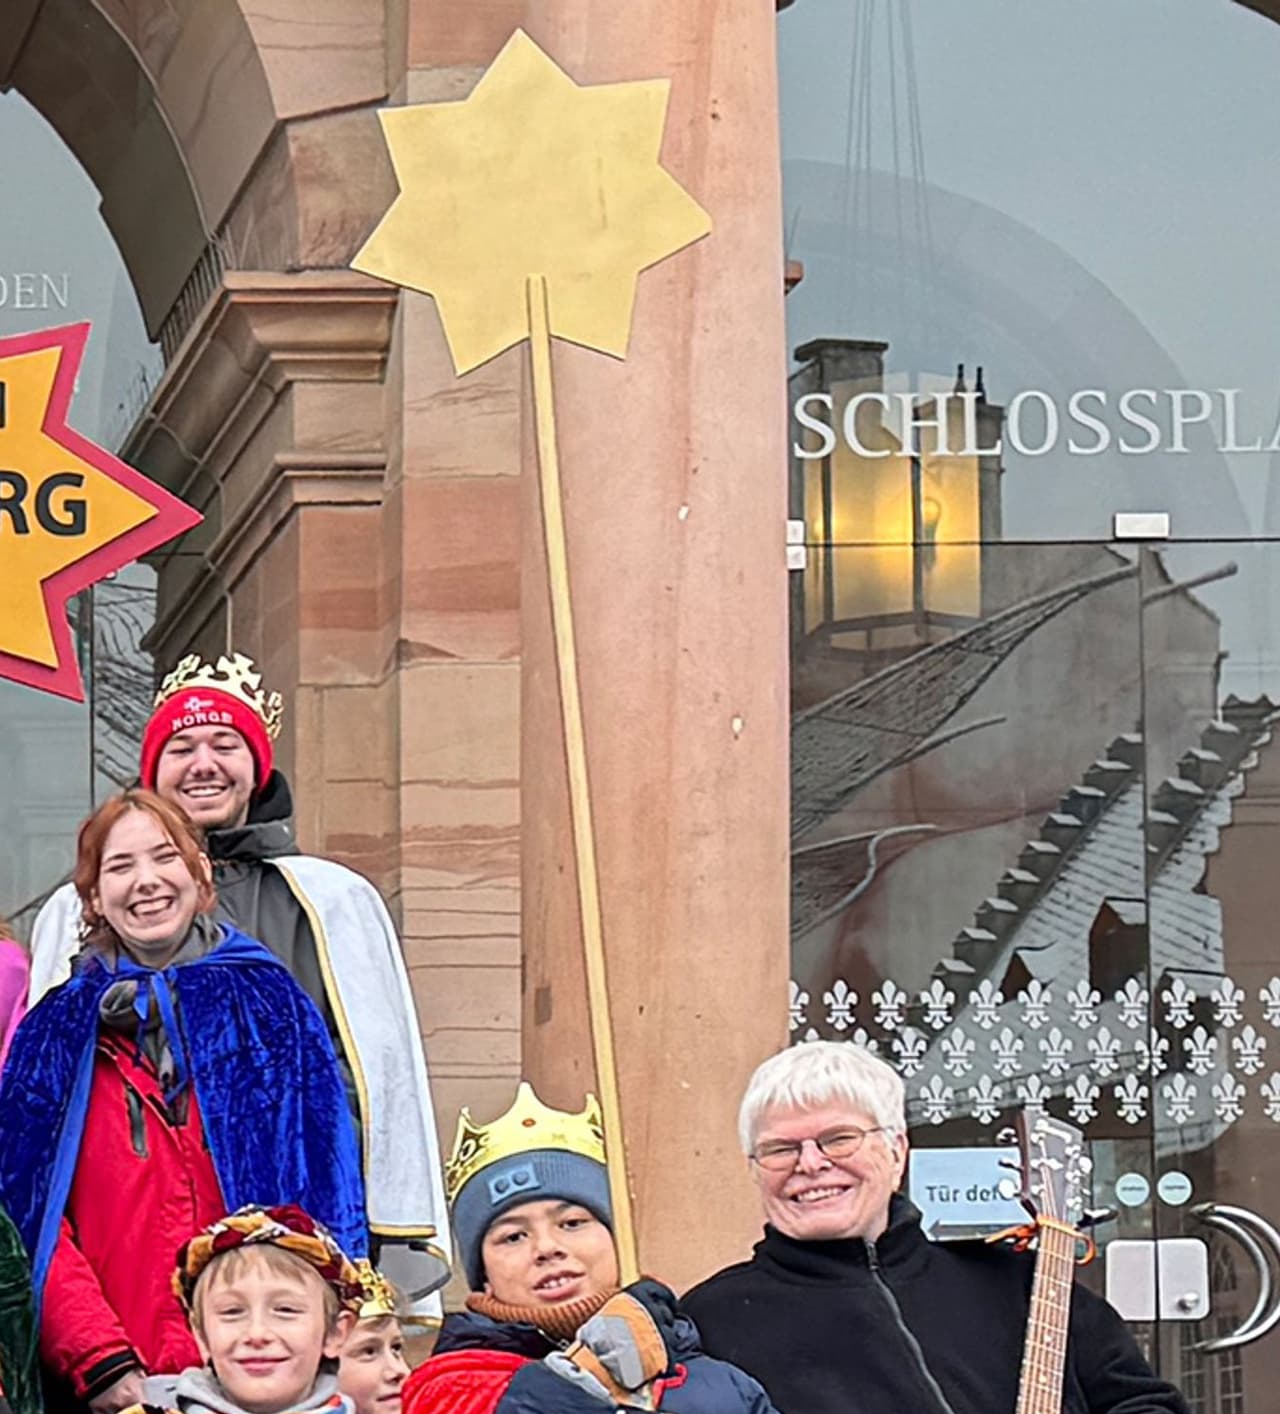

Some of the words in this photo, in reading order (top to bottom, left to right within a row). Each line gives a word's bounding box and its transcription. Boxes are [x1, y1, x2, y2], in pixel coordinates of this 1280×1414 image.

[793, 388, 1280, 459] SCHLOSSPL
[171, 710, 233, 732] NORGE
[925, 1184, 960, 1203] Tür
